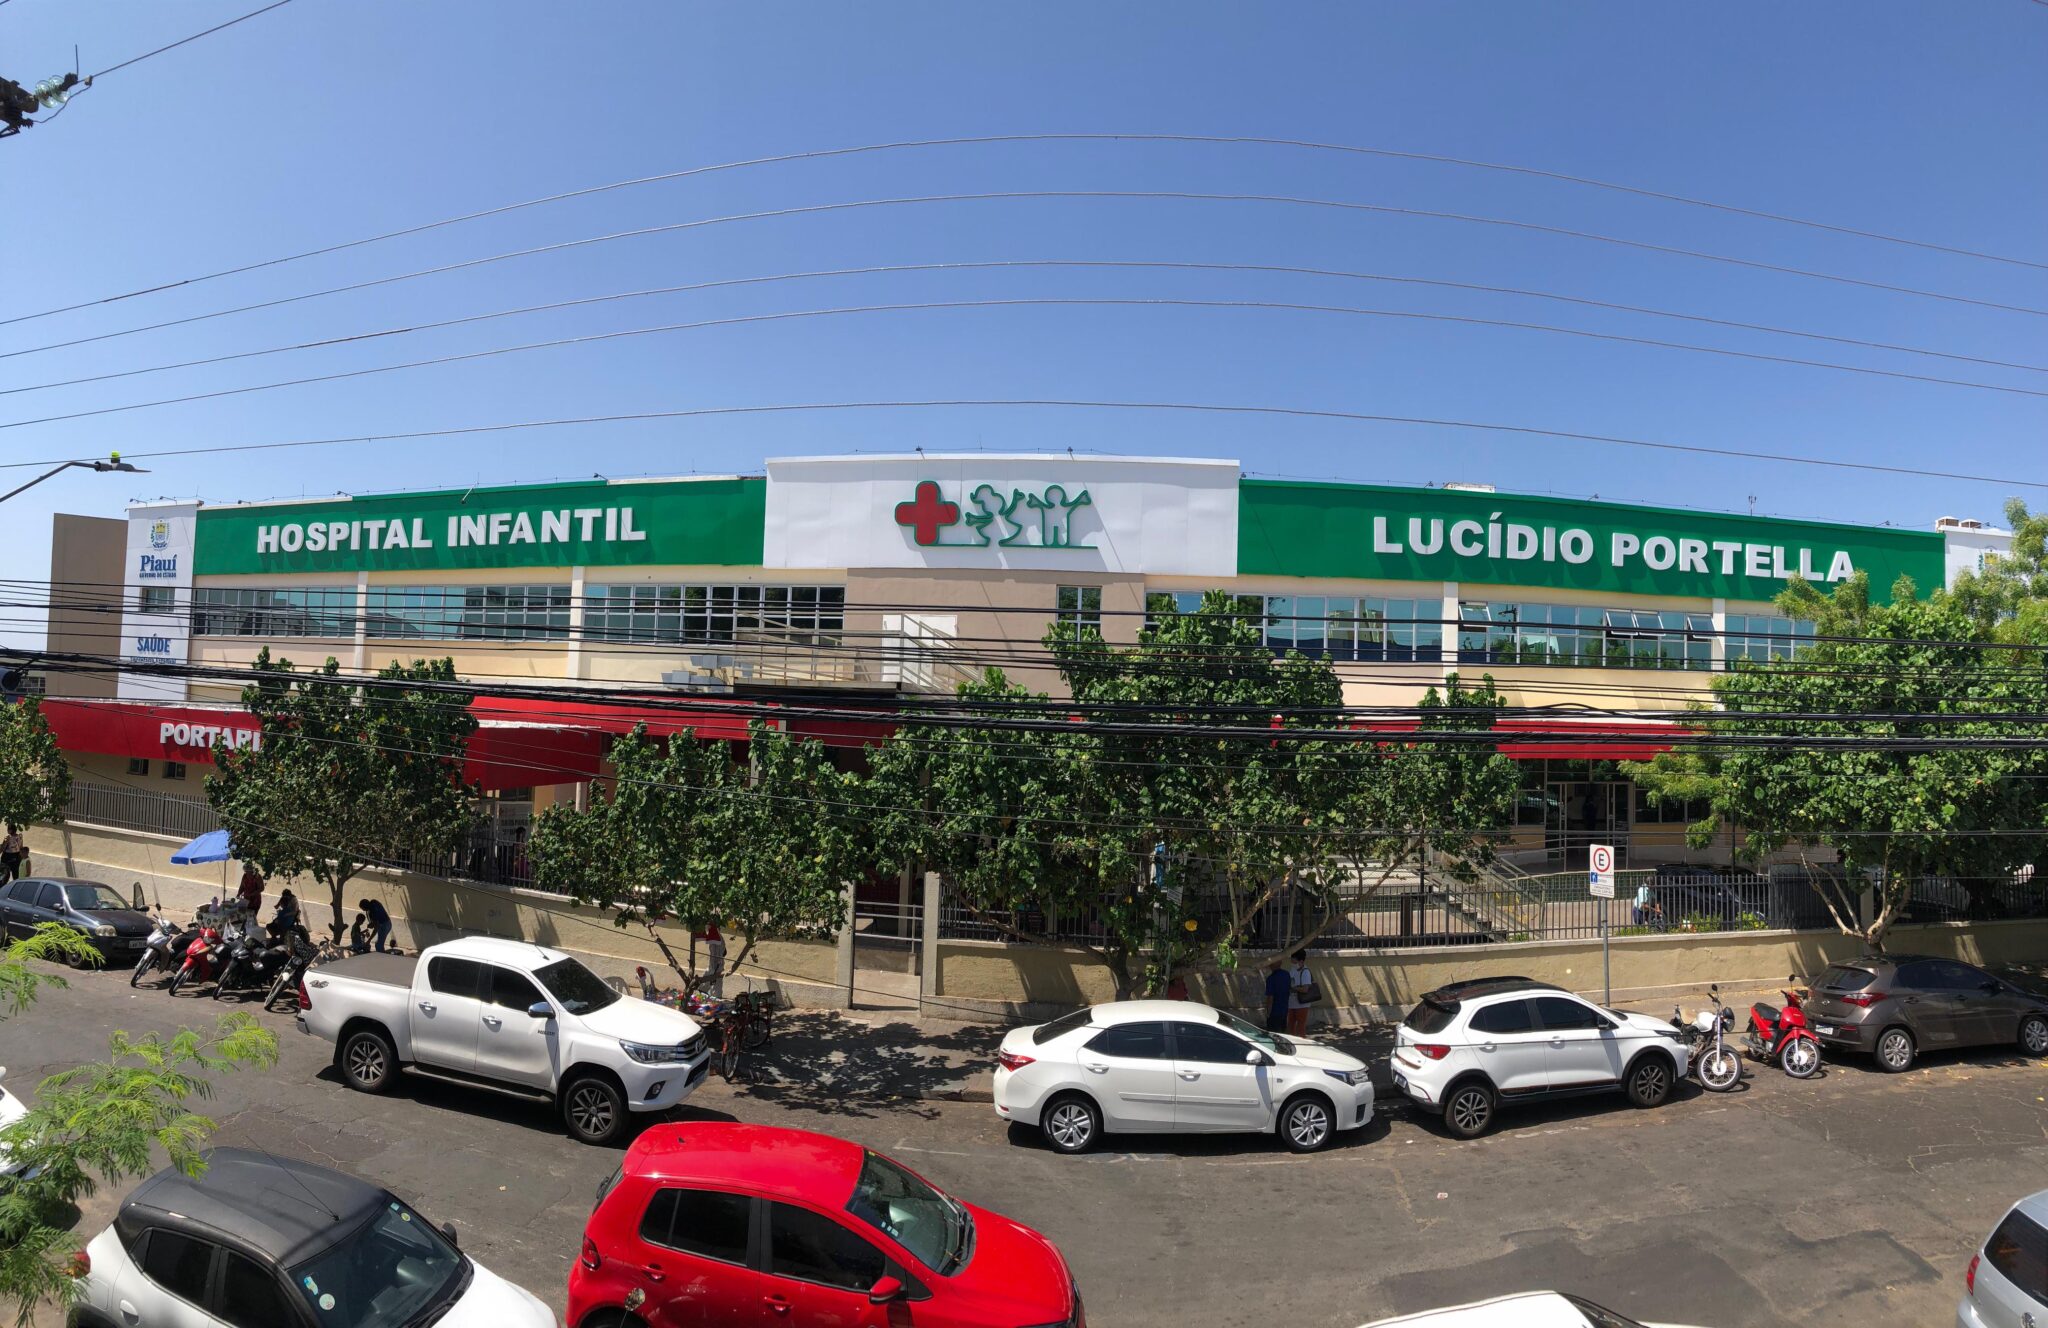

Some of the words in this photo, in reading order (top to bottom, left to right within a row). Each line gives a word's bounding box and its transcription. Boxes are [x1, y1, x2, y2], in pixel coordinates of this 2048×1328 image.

[257, 518, 433, 553] HOSPITAL
[447, 507, 646, 547] INFANTIL
[1373, 511, 1594, 564] LUCÍDIO
[1611, 532, 1855, 582] PORTELLA
[140, 554, 177, 571] Piauí
[137, 633, 171, 653] SAÚDE
[1598, 853, 1605, 867] E
